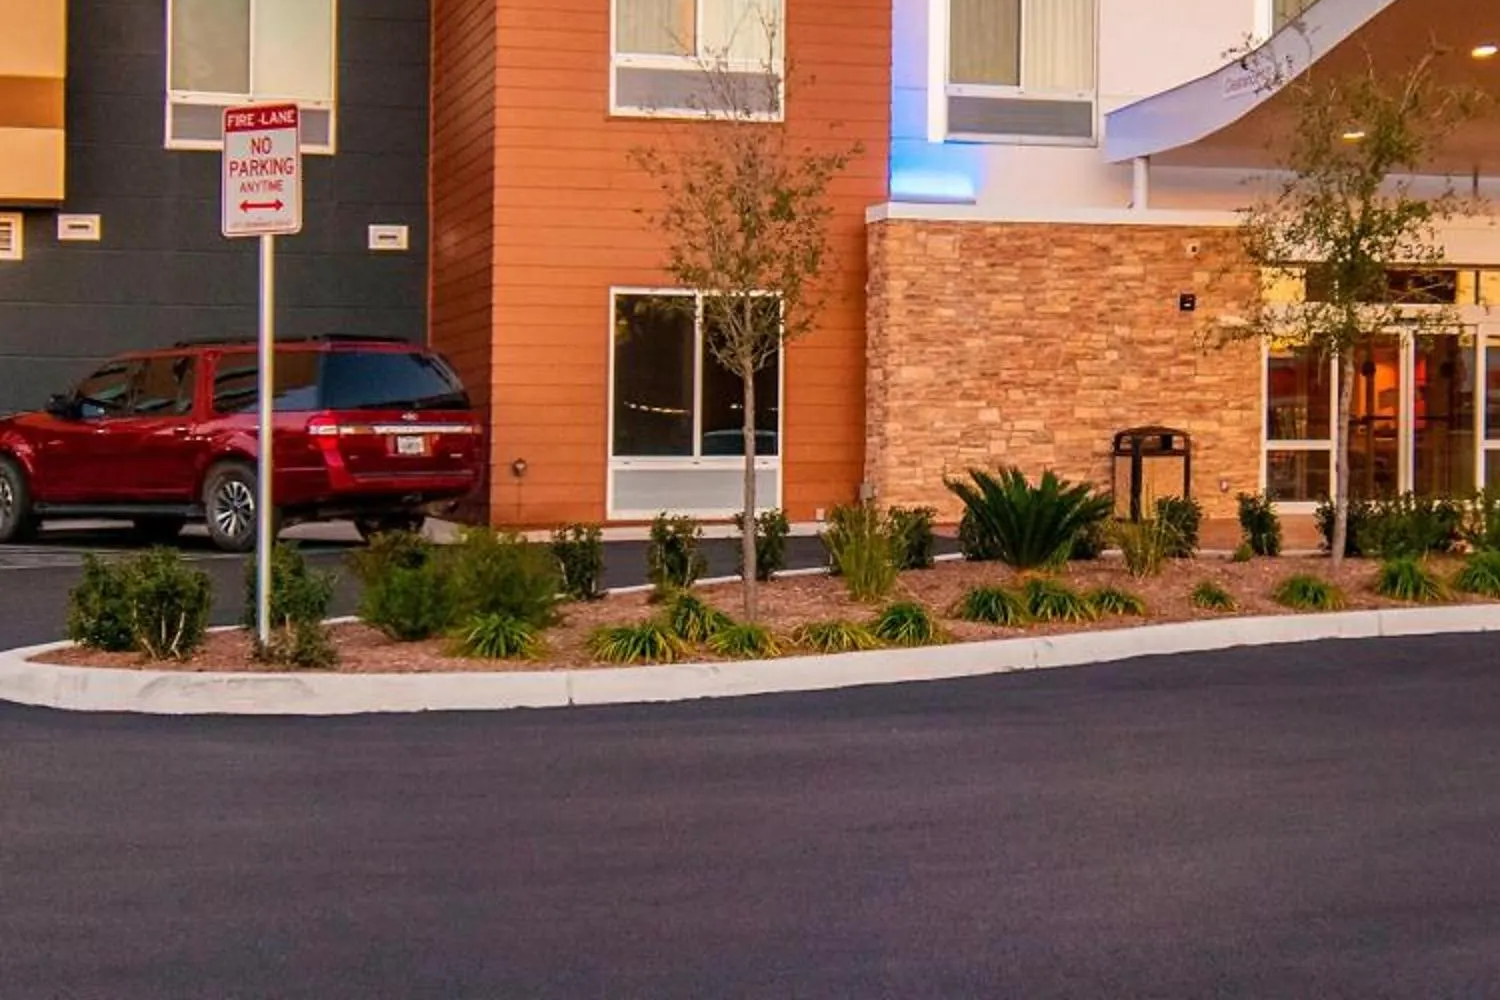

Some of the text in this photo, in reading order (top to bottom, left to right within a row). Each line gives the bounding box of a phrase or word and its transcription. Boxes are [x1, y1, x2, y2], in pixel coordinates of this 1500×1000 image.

[227, 113, 255, 127] FIRE
[251, 137, 272, 154] NO
[229, 157, 294, 177] PARKING
[240, 179, 284, 192] ANYTIME
